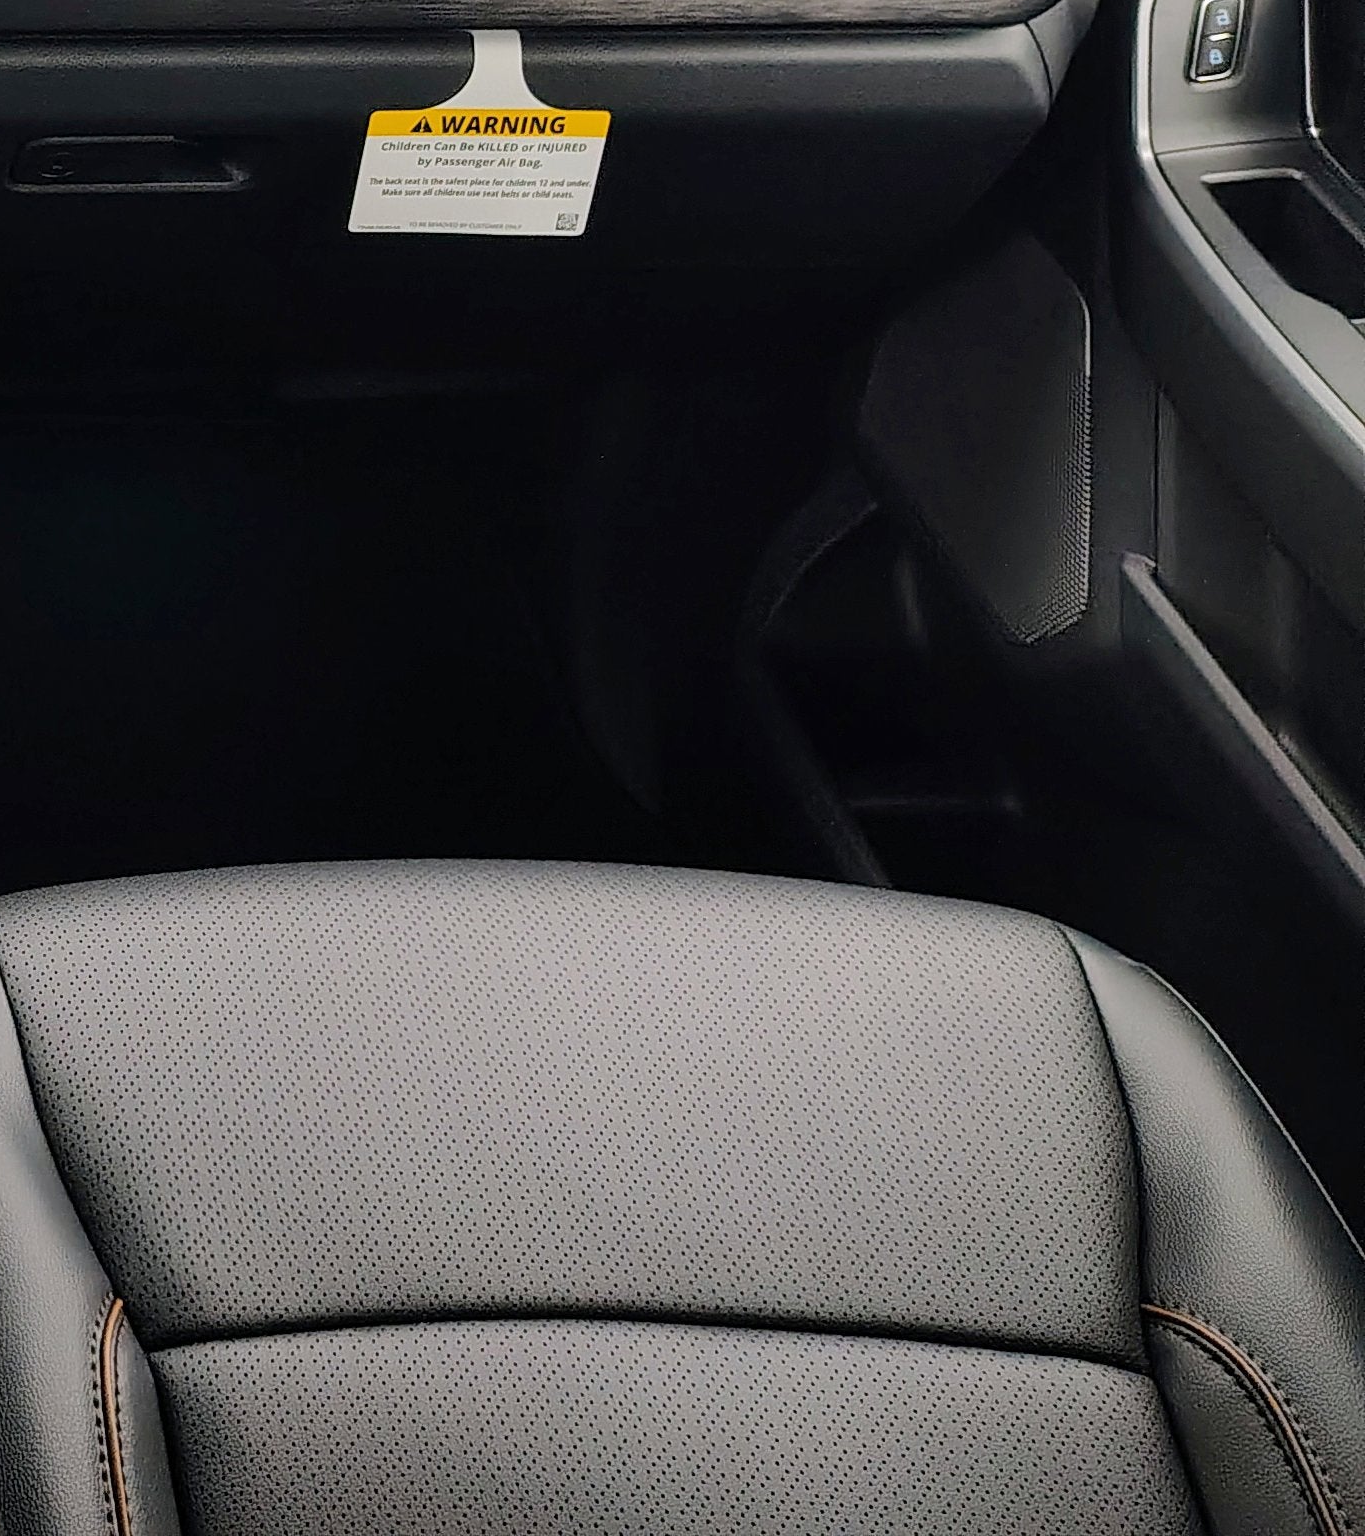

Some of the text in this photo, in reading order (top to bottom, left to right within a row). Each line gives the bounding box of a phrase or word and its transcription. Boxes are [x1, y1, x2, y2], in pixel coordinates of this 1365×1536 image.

[441, 116, 567, 134] WARNING
[381, 141, 587, 153] Children Can Be KILLED or INJURED
[418, 157, 543, 169] by Passenger Air Bag.
